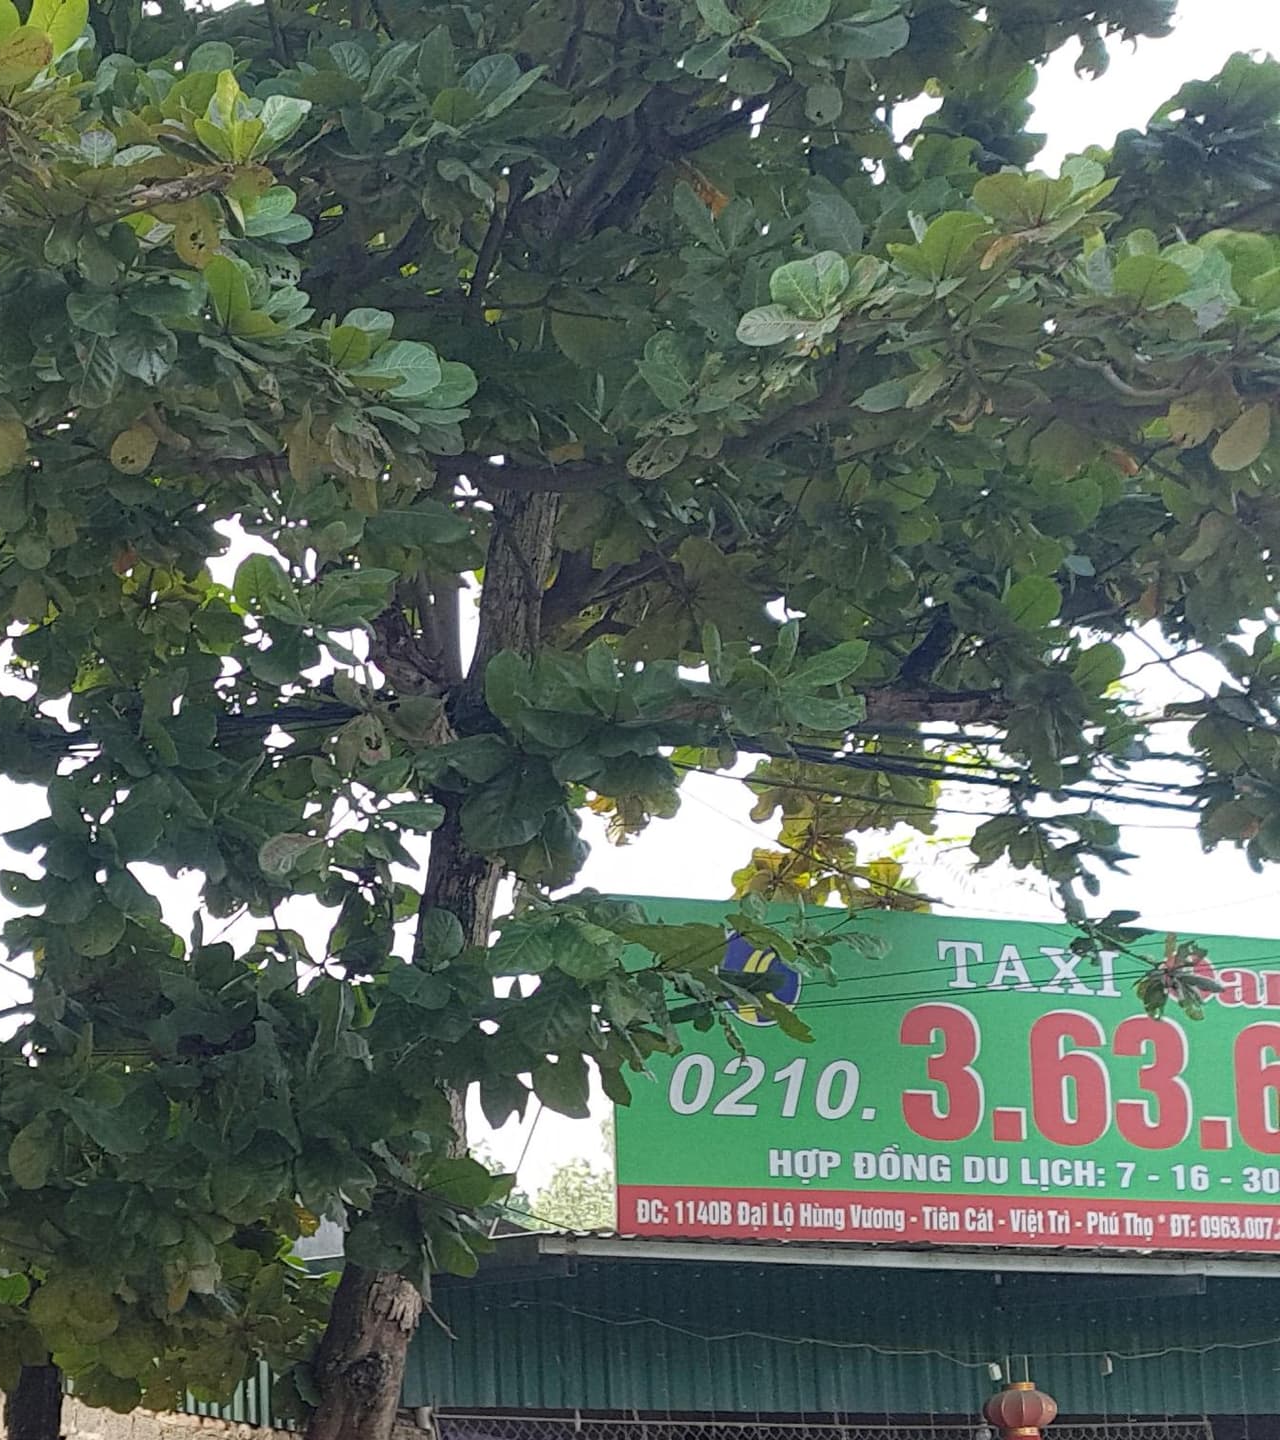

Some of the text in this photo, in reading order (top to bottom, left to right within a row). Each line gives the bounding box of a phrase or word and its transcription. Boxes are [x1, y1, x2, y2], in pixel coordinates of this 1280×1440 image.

[938, 940, 1122, 998] TAXI
[667, 1052, 876, 1121] 0210.
[768, 1148, 841, 1184] HỢP
[852, 1143, 952, 1182] ĐỒNG
[963, 1155, 1009, 1184] DU
[1020, 1157, 1106, 1191] LỊCH:
[1116, 1161, 1137, 1189] 7
[1171, 1164, 1210, 1191] 16
[1242, 1167, 1280, 1194] 30
[636, 1198, 670, 1225] ĐC:
[675, 1199, 732, 1226] 1140B
[737, 1200, 768, 1231] Đại
[773, 1202, 794, 1232] Lộ
[799, 1202, 845, 1230] Hùng
[850, 1204, 906, 1233] Vương
[922, 1205, 959, 1232] Tiên
[964, 1206, 994, 1233] Cát
[1009, 1207, 1043, 1238] Việt
[1047, 1209, 1070, 1235] Trì
[1087, 1209, 1120, 1236] Phú
[1124, 1211, 1154, 1241] Thọ
[1170, 1213, 1196, 1237] ĐT:
